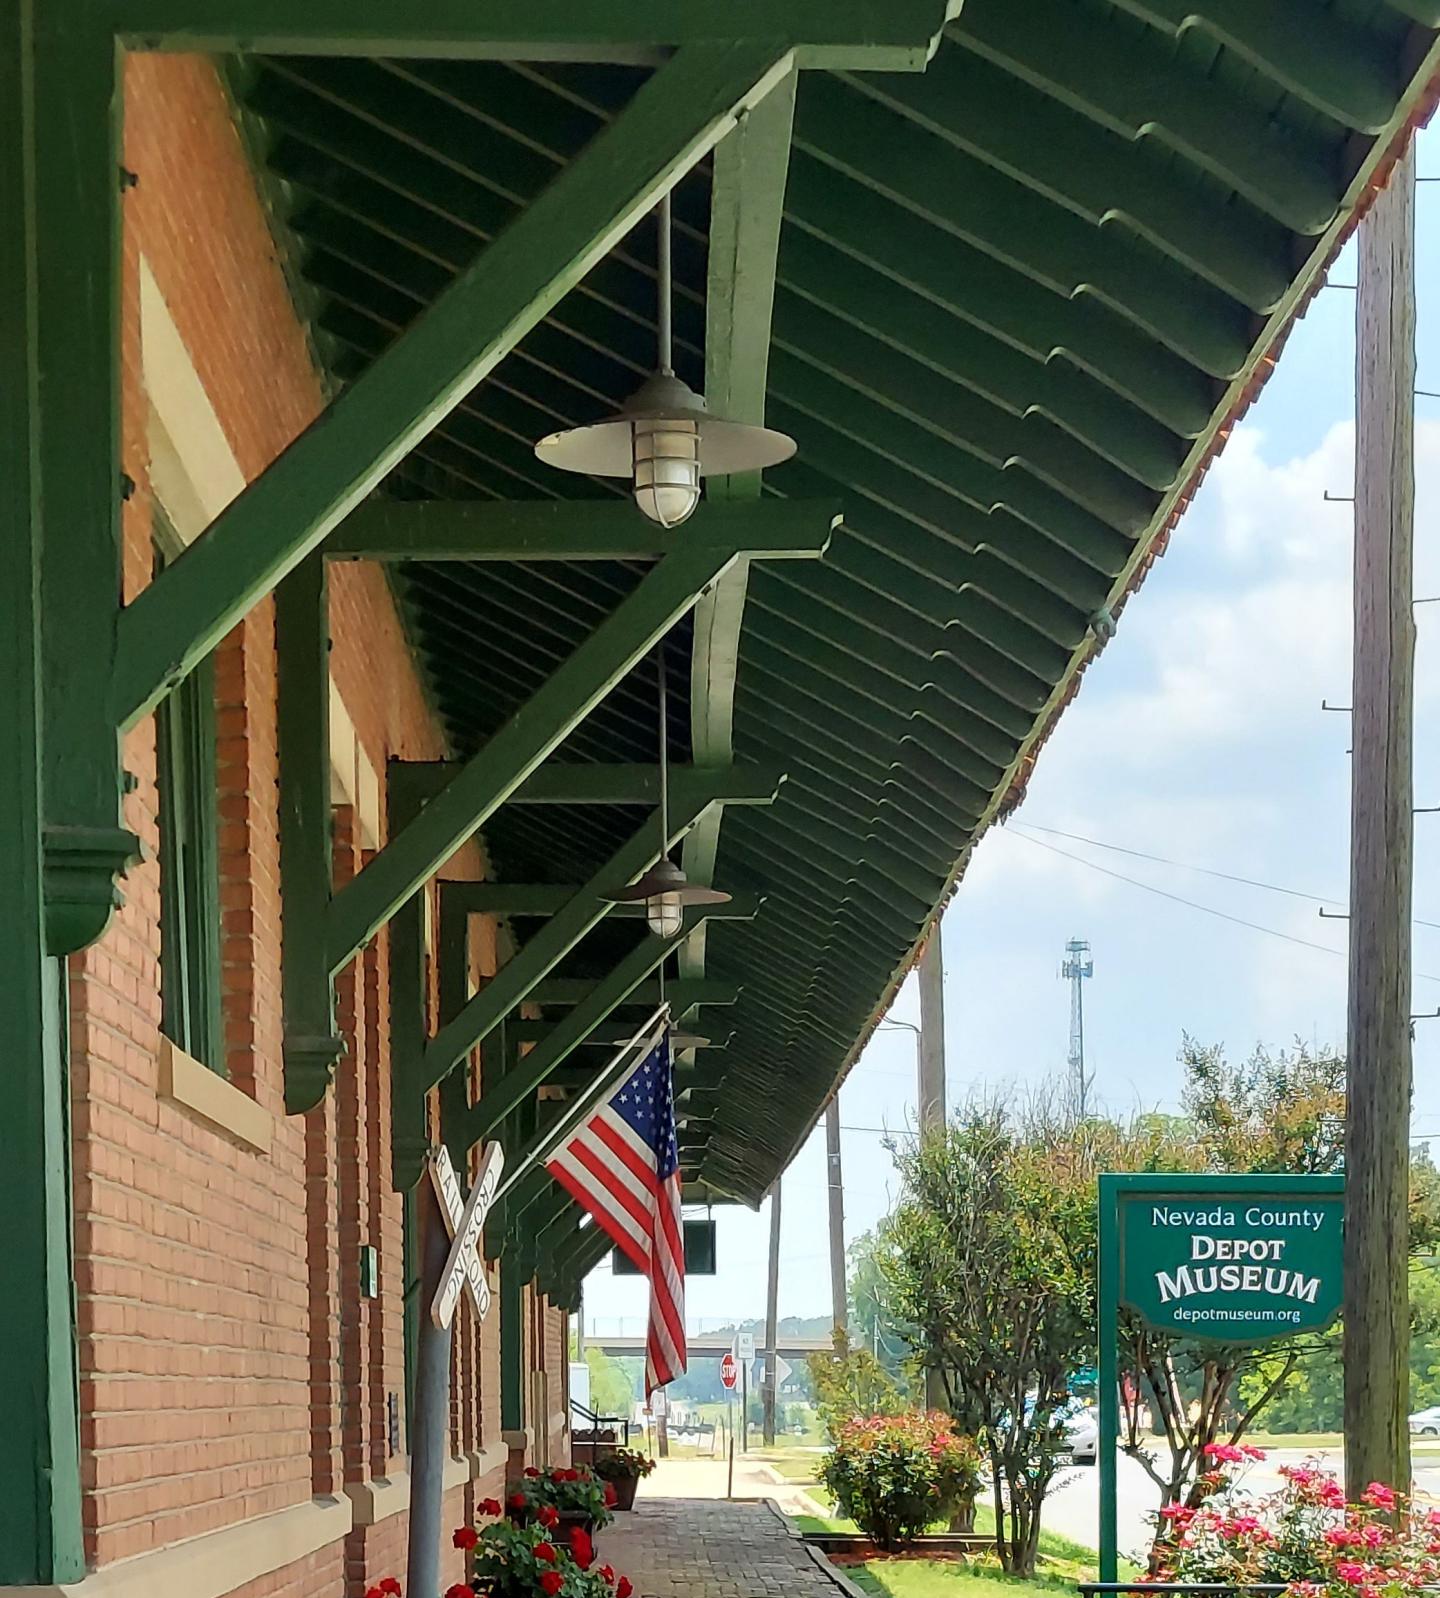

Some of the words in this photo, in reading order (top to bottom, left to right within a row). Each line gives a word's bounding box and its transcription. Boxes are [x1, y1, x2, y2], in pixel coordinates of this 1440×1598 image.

[438, 1150, 459, 1227] RAIL
[1151, 1206, 1236, 1227] Nevada
[1245, 1207, 1325, 1230] County
[448, 1169, 494, 1304] CROSSING
[1190, 1234, 1286, 1260] DEPOT
[1154, 1264, 1322, 1304] MUSEUM
[1173, 1306, 1301, 1323] depotmuseum.org
[722, 1364, 737, 1378] STOP
